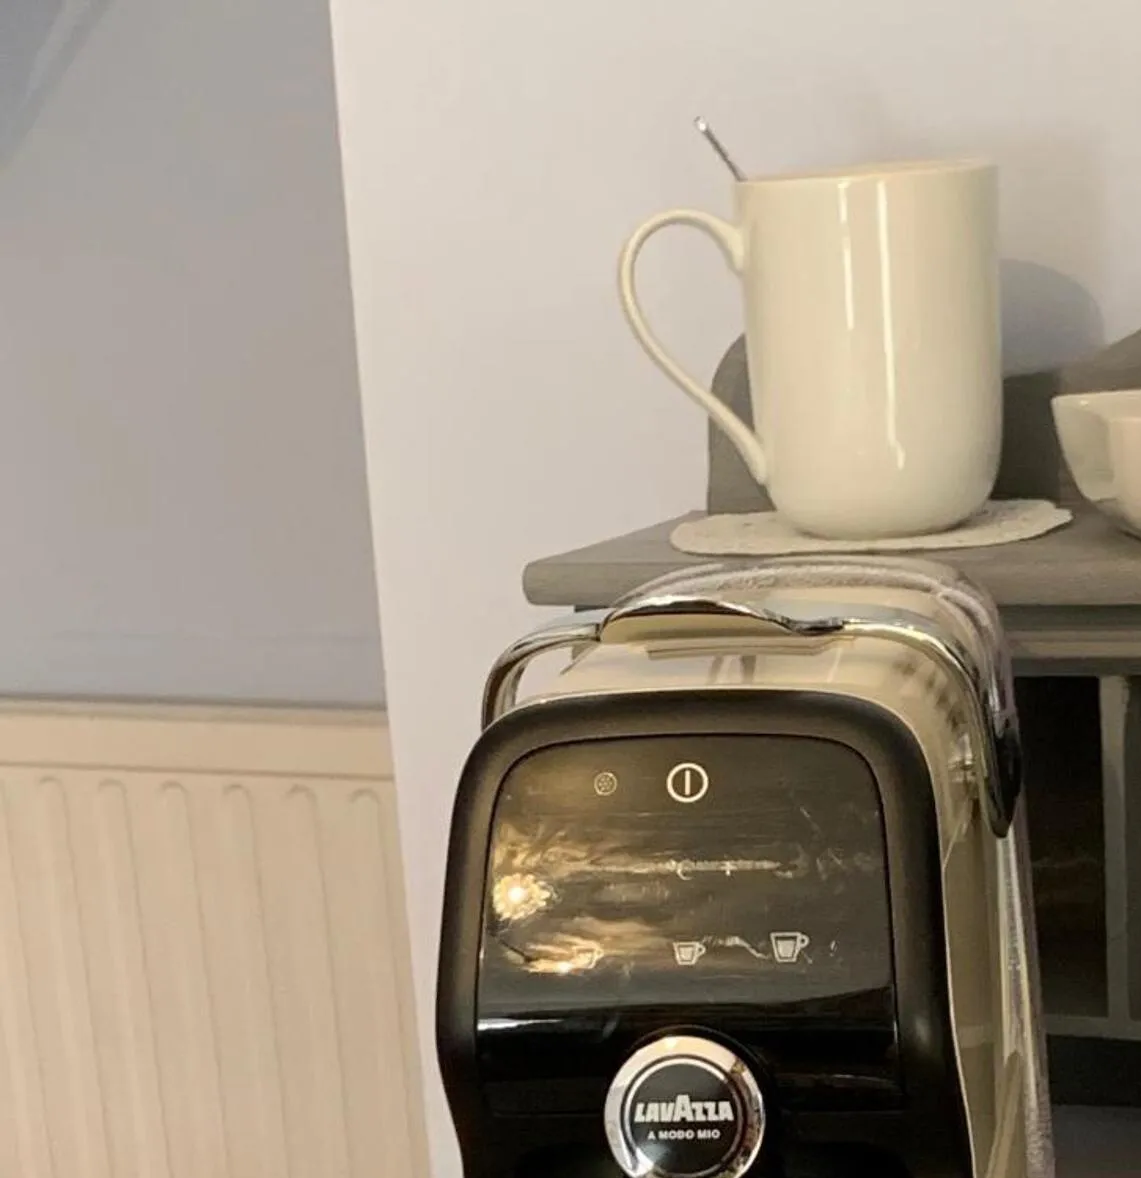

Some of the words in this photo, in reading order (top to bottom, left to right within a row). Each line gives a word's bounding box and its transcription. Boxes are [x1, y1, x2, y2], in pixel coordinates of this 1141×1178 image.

[633, 1094, 734, 1123] LAVAZZA
[647, 1130, 657, 1141] A
[658, 1129, 695, 1140] MODO
[697, 1128, 721, 1140] MIO
